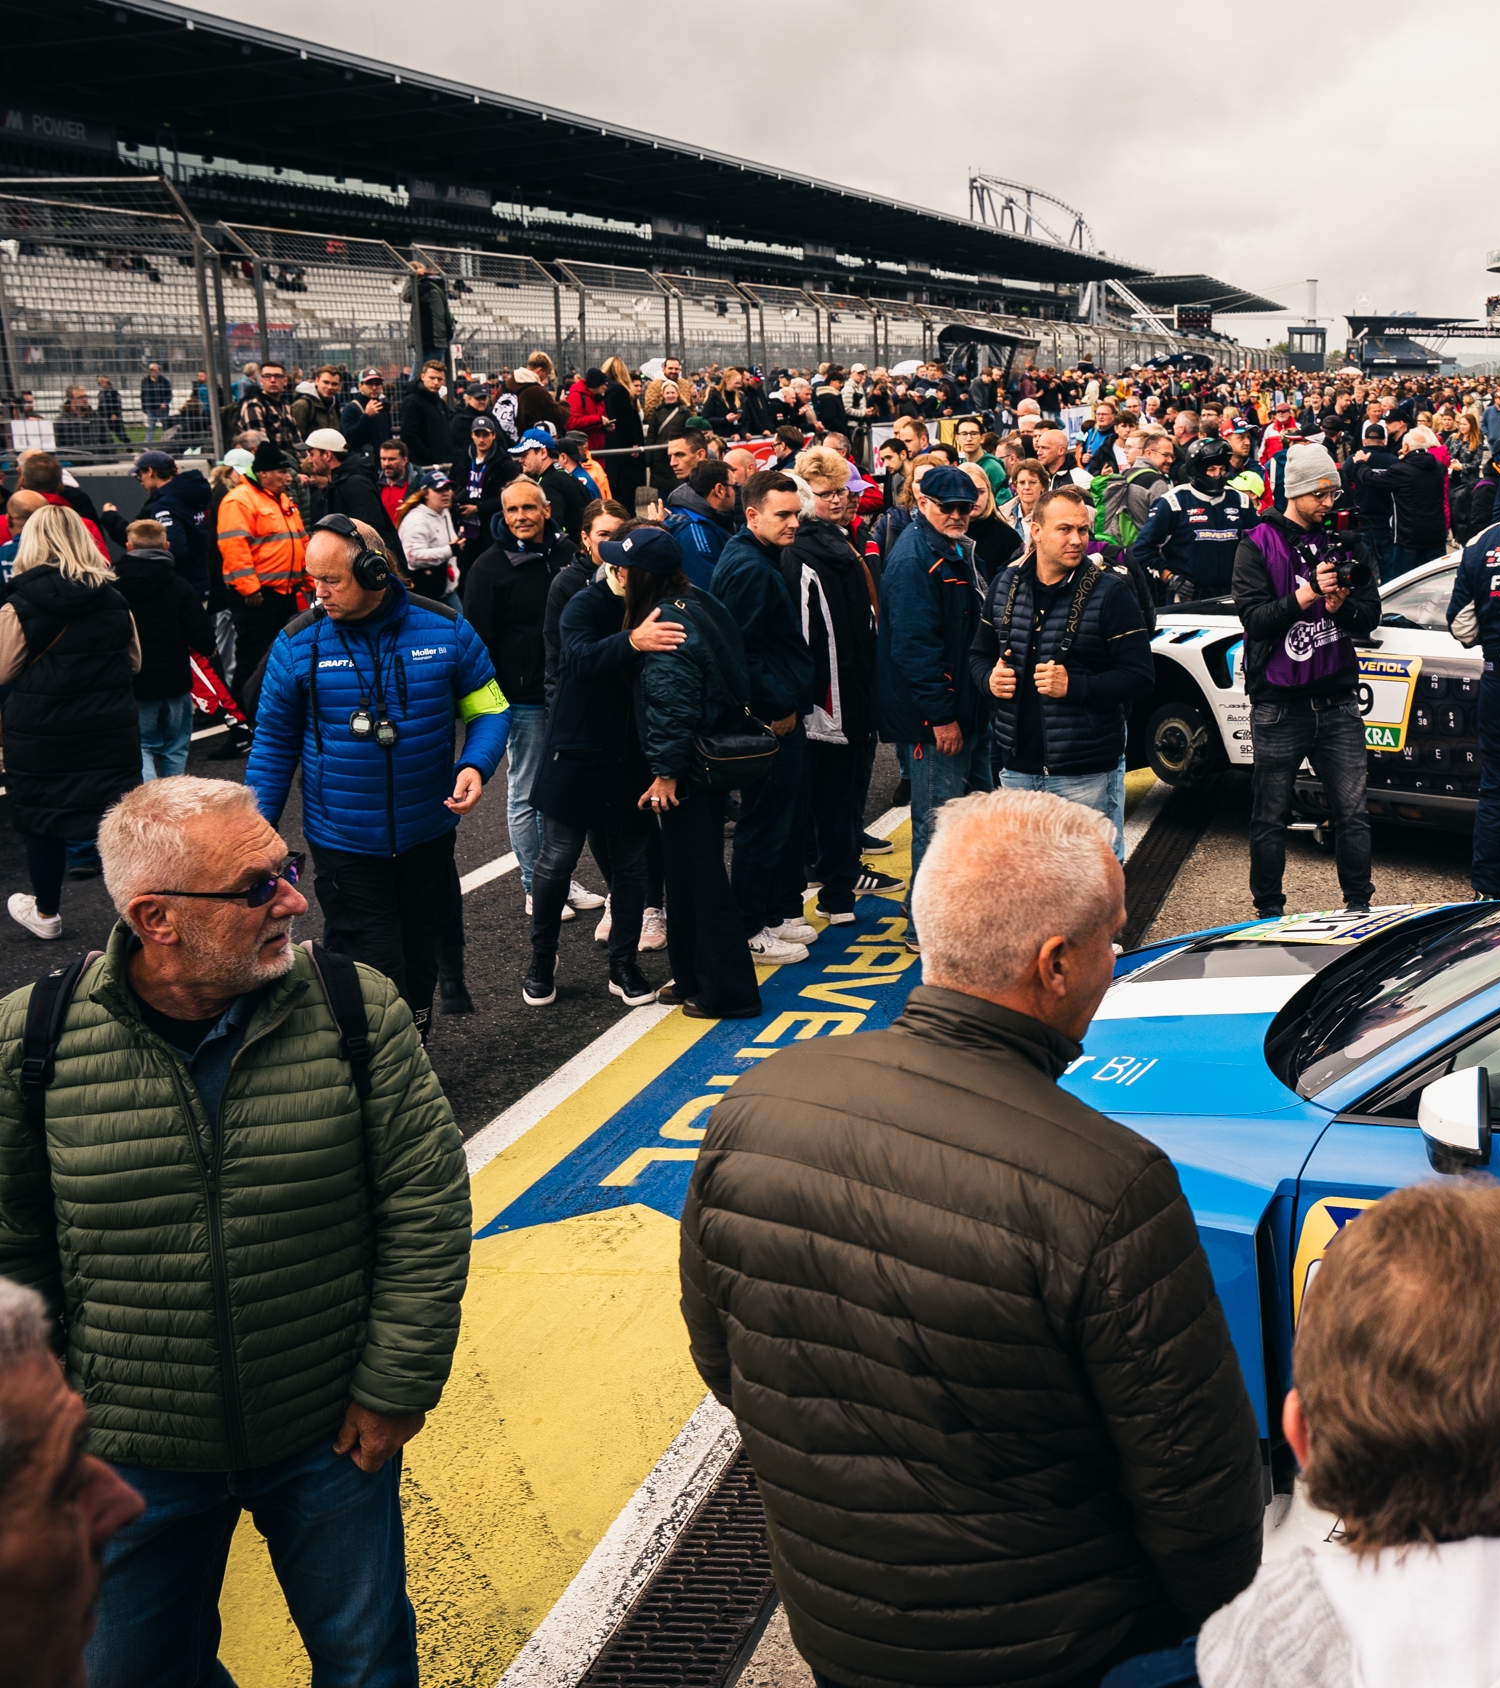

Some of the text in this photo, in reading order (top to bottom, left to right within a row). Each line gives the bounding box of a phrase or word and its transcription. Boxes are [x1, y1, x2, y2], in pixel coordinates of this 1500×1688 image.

[32, 114, 87, 142] POWER
[1406, 328, 1449, 337] Nürburgring
[318, 659, 348, 668] CRAFT
[1358, 661, 1405, 674] VENOL
[1365, 726, 1396, 747] KRA
[1435, 749, 1441, 759] E
[1466, 751, 1474, 762] R
